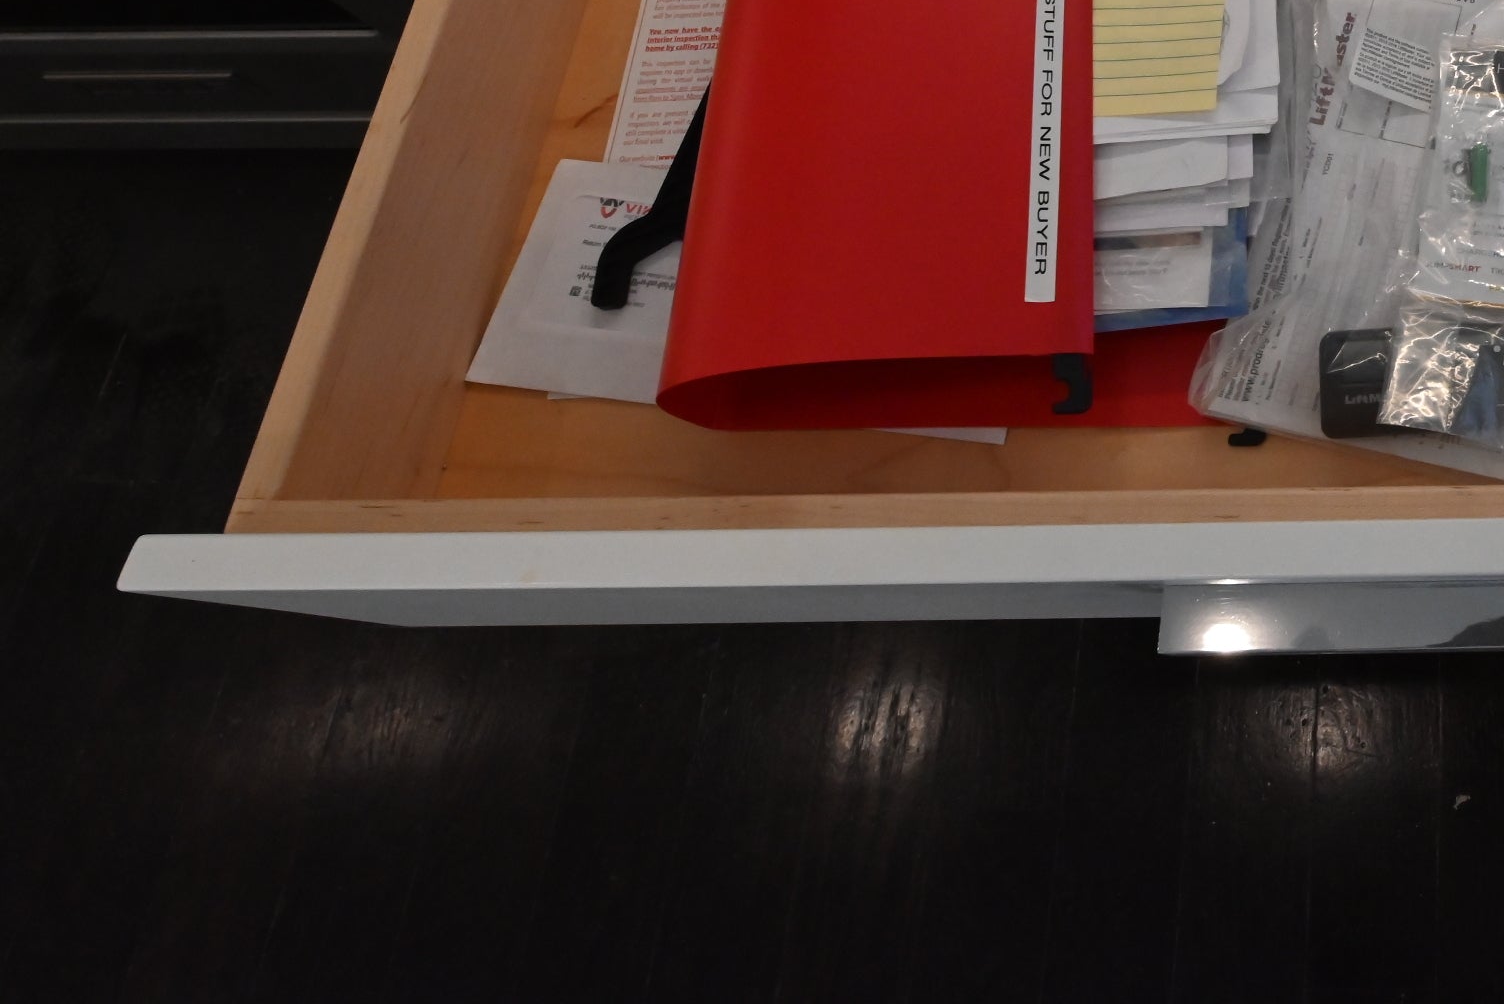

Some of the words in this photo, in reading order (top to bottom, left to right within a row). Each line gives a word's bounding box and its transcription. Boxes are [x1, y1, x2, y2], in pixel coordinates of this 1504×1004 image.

[650, 28, 662, 36] You
[664, 27, 679, 35] now
[681, 26, 699, 34] have
[674, 34, 709, 44] inspection
[644, 45, 665, 53] home
[664, 43, 675, 53] by
[675, 42, 699, 52] calling
[1040, 69, 1054, 118] FOR
[1038, 125, 1052, 182] NEW
[1034, 191, 1051, 276] BUYER
